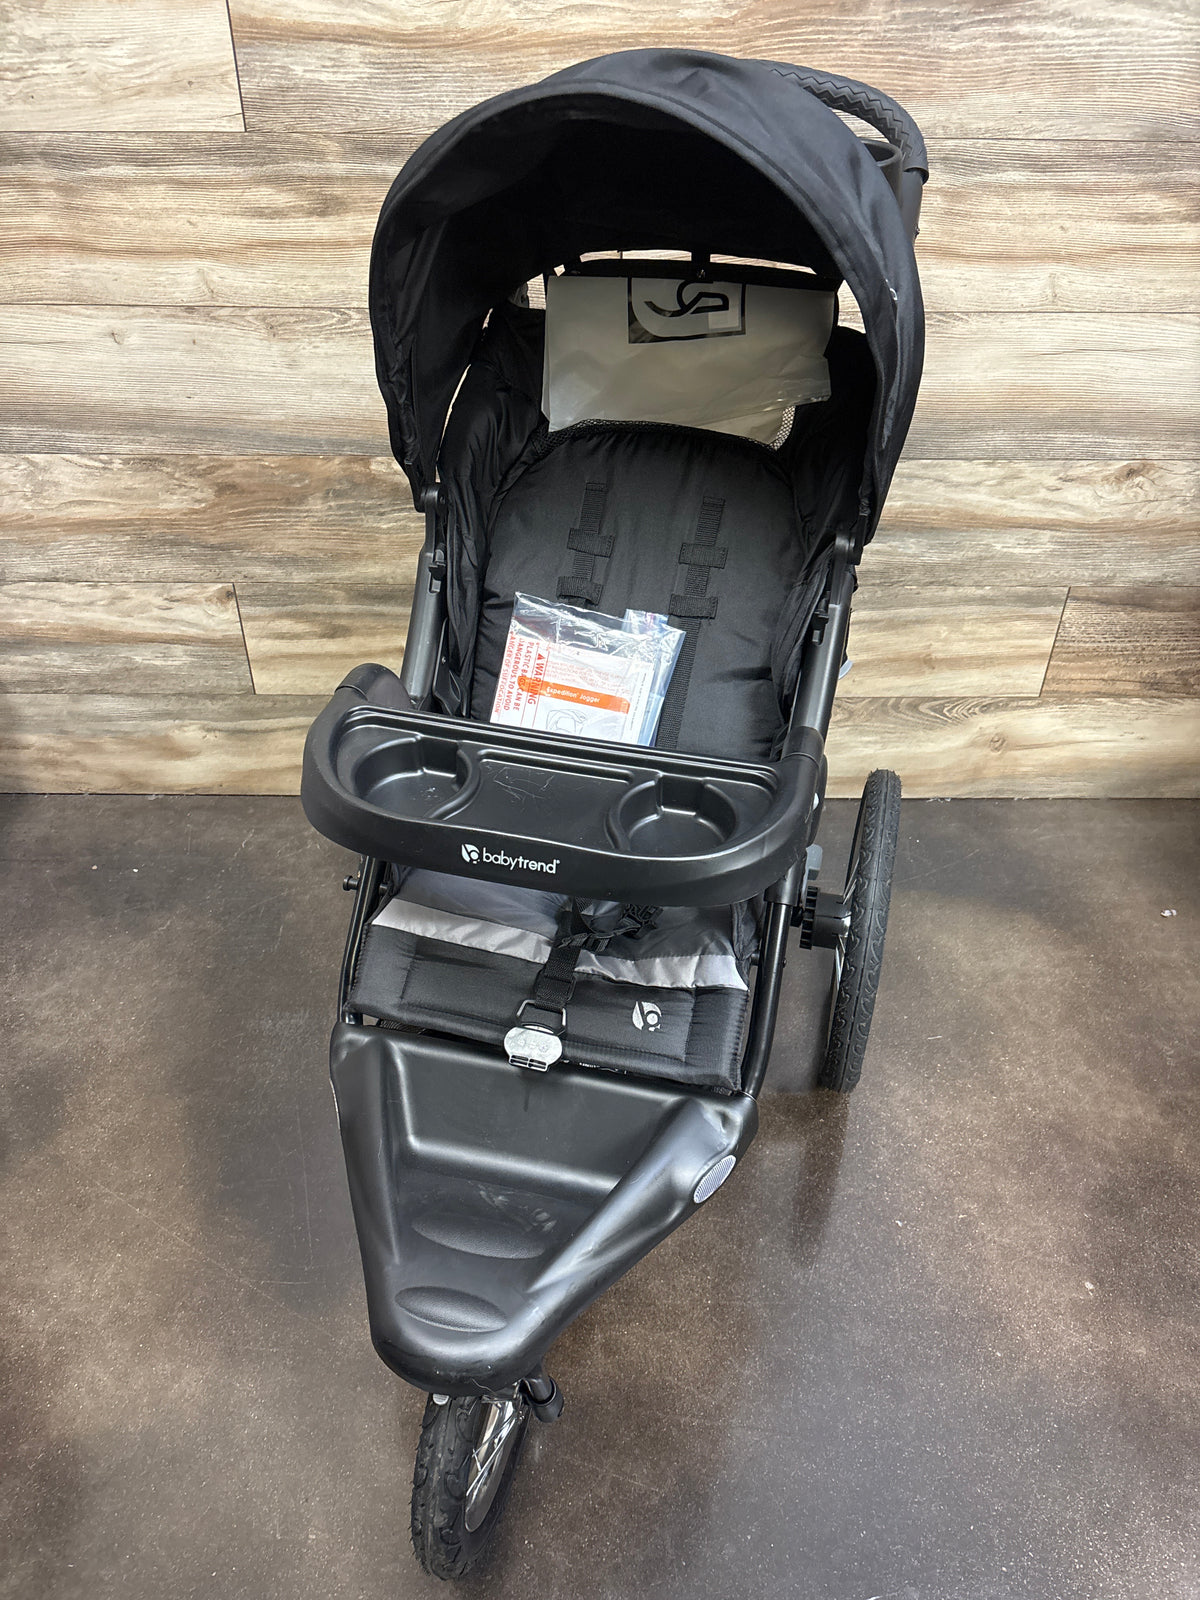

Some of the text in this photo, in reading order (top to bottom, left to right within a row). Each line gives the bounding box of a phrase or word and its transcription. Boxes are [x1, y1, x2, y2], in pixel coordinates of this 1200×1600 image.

[523, 641, 534, 668] PLASTIC
[507, 680, 515, 689] TO
[526, 661, 544, 705] WARNING
[503, 690, 513, 710] AVOID
[515, 687, 523, 701] CAN
[546, 686, 600, 704] Expedition Jogger
[513, 702, 520, 711] BE
[482, 846, 557, 874] babytrend
